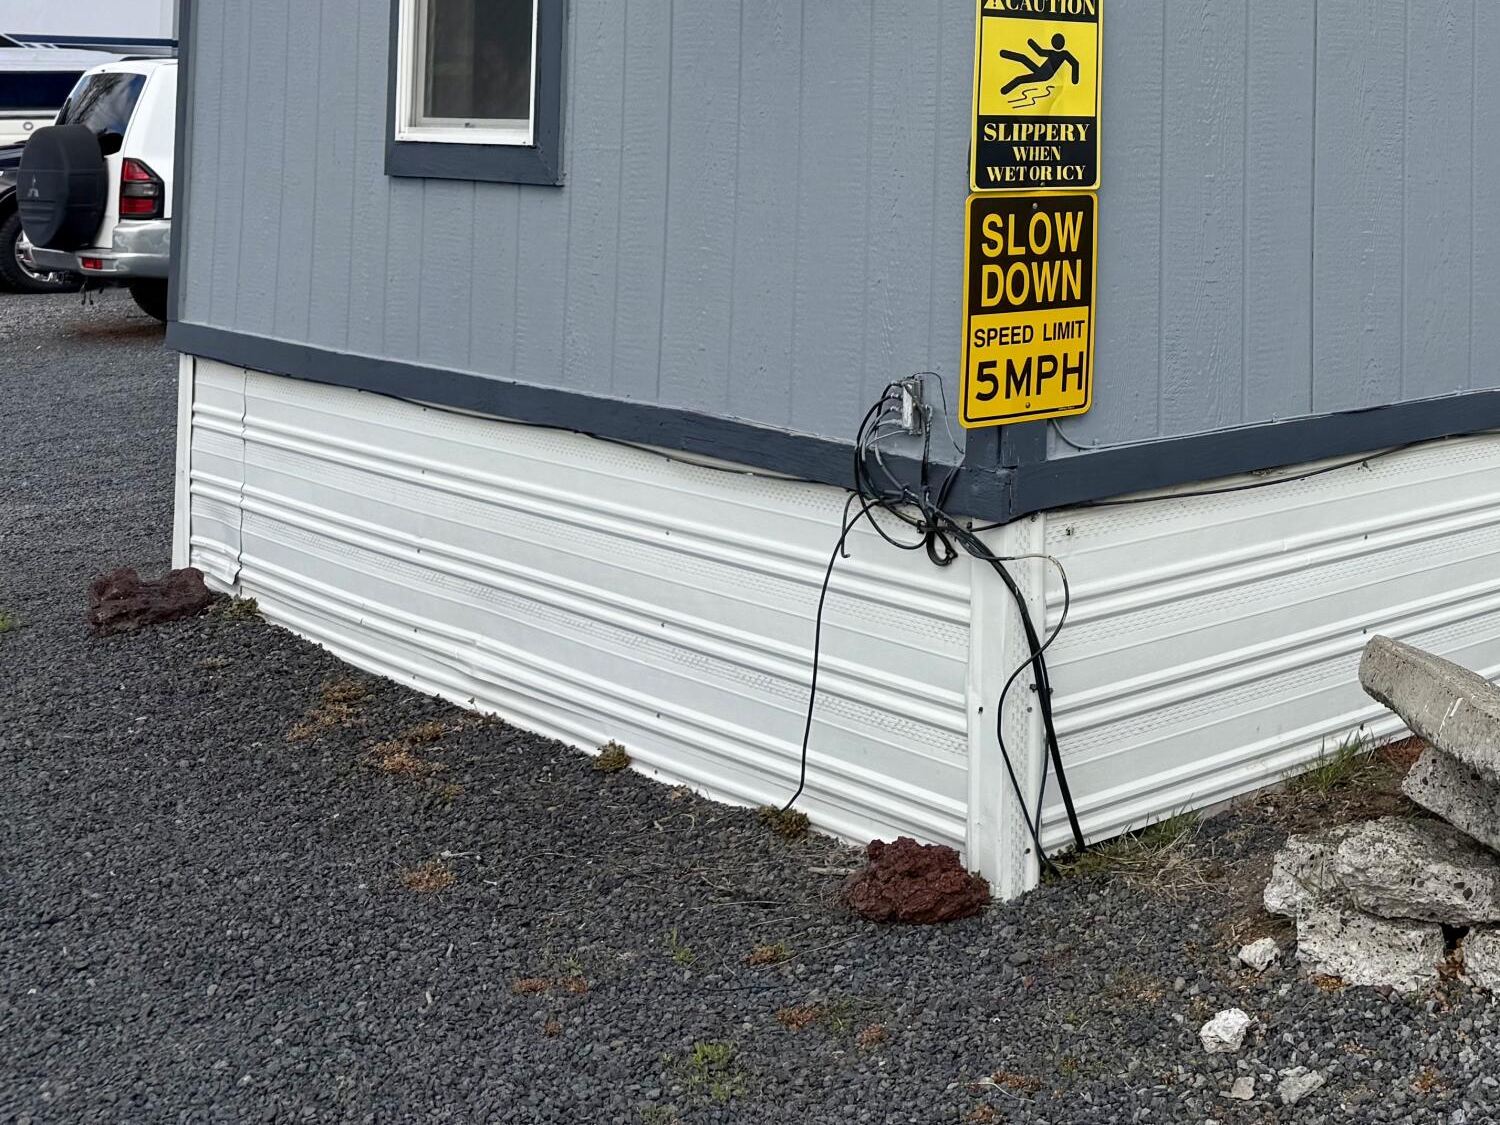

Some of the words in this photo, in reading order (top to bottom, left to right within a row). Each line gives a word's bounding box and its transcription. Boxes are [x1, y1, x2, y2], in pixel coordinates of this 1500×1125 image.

[983, 123, 1090, 142] SLIPPERY
[1012, 145, 1061, 162] WHEN
[986, 166, 1028, 182] WET
[1029, 165, 1053, 181] OR
[1056, 164, 1086, 180] ICY
[981, 211, 1084, 258] SLOW
[980, 259, 1082, 307] DOWN
[973, 324, 1034, 348] SPEED
[1042, 320, 1086, 342] LIMIT
